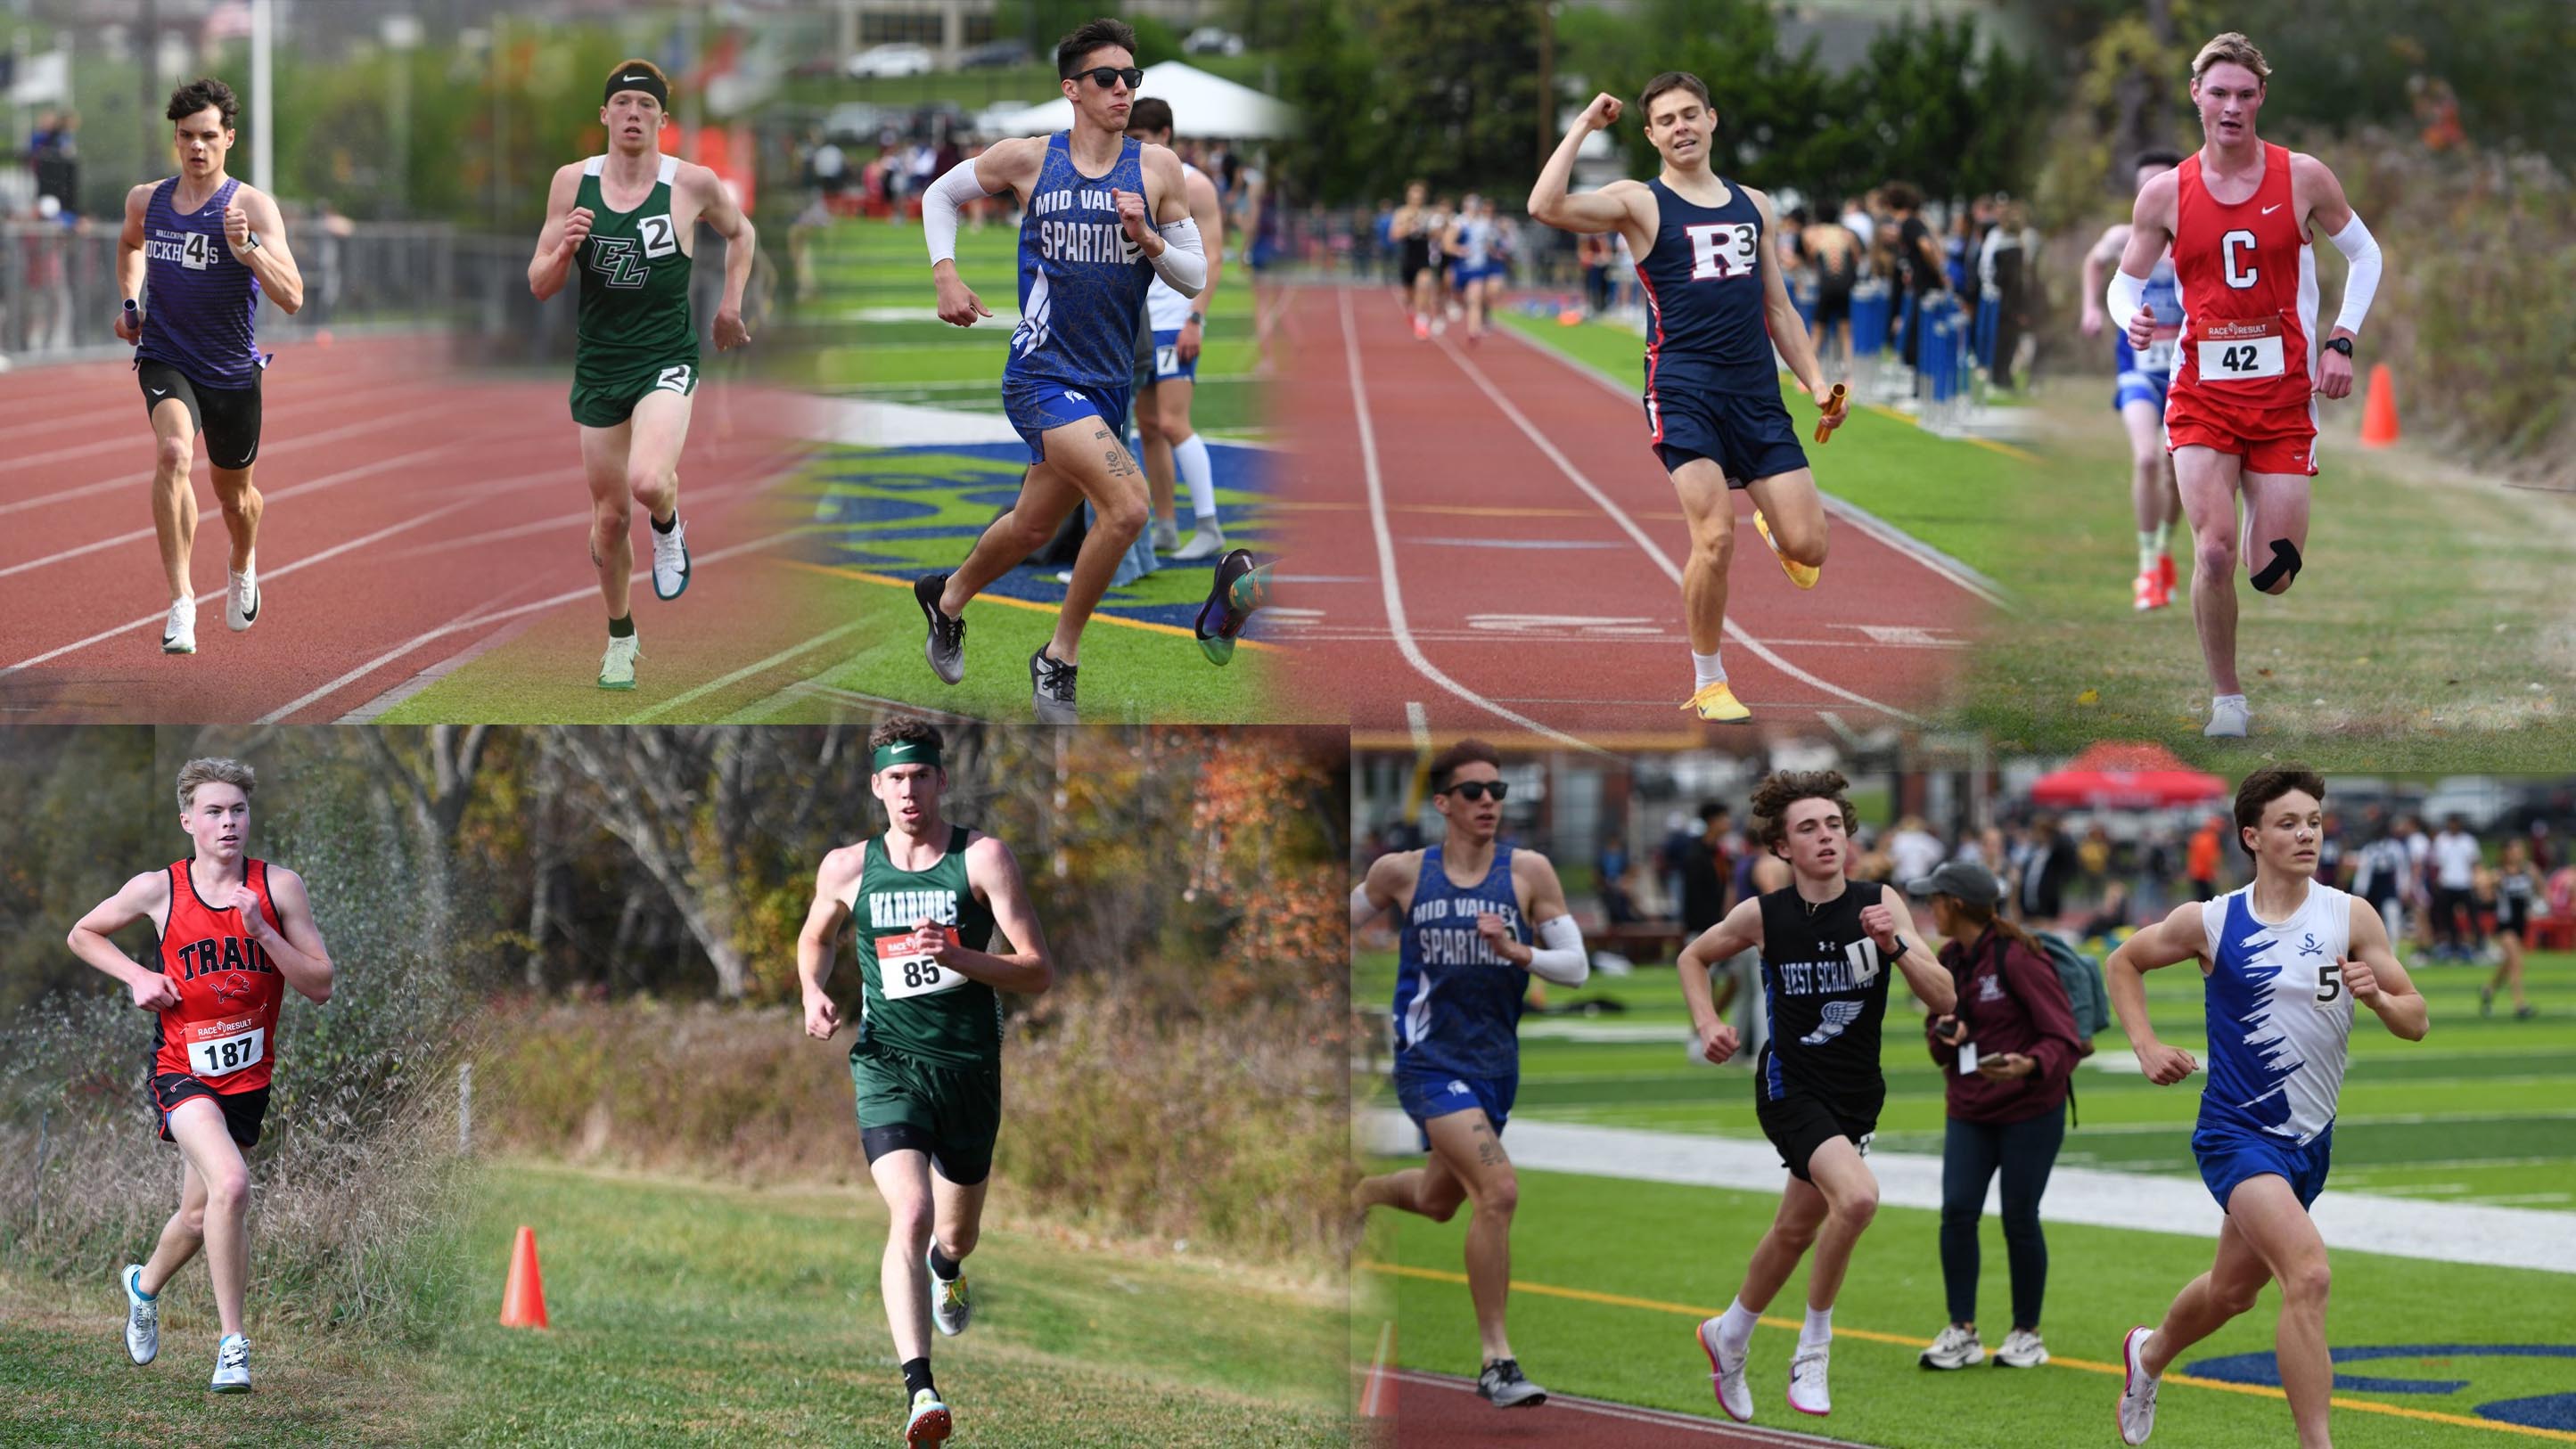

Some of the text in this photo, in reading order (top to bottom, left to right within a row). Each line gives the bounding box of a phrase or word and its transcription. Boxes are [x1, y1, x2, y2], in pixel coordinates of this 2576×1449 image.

[1036, 190, 1071, 217] MID
[185, 233, 205, 264] 4
[644, 218, 673, 251] 2
[1041, 220, 1128, 265] SPARTAN
[1734, 225, 1756, 257] 3
[589, 234, 650, 289] EL
[1683, 221, 1753, 282] R
[2221, 228, 2259, 291] C
[2208, 327, 2229, 336] RACE
[2238, 323, 2267, 334] RESULT
[2222, 345, 2259, 372] 42
[662, 365, 686, 389] 2
[869, 890, 958, 928] WARRIORS
[1413, 899, 1448, 926] MID
[2304, 933, 2316, 948] S
[178, 936, 272, 982] TRAIL
[1857, 942, 1870, 972] 1
[903, 959, 940, 988] 85
[1779, 962, 1813, 995] WEST
[2317, 965, 2341, 1003] 5
[198, 1026, 217, 1037] RACE
[226, 1019, 252, 1032] RESULT
[204, 1036, 253, 1071] 187
